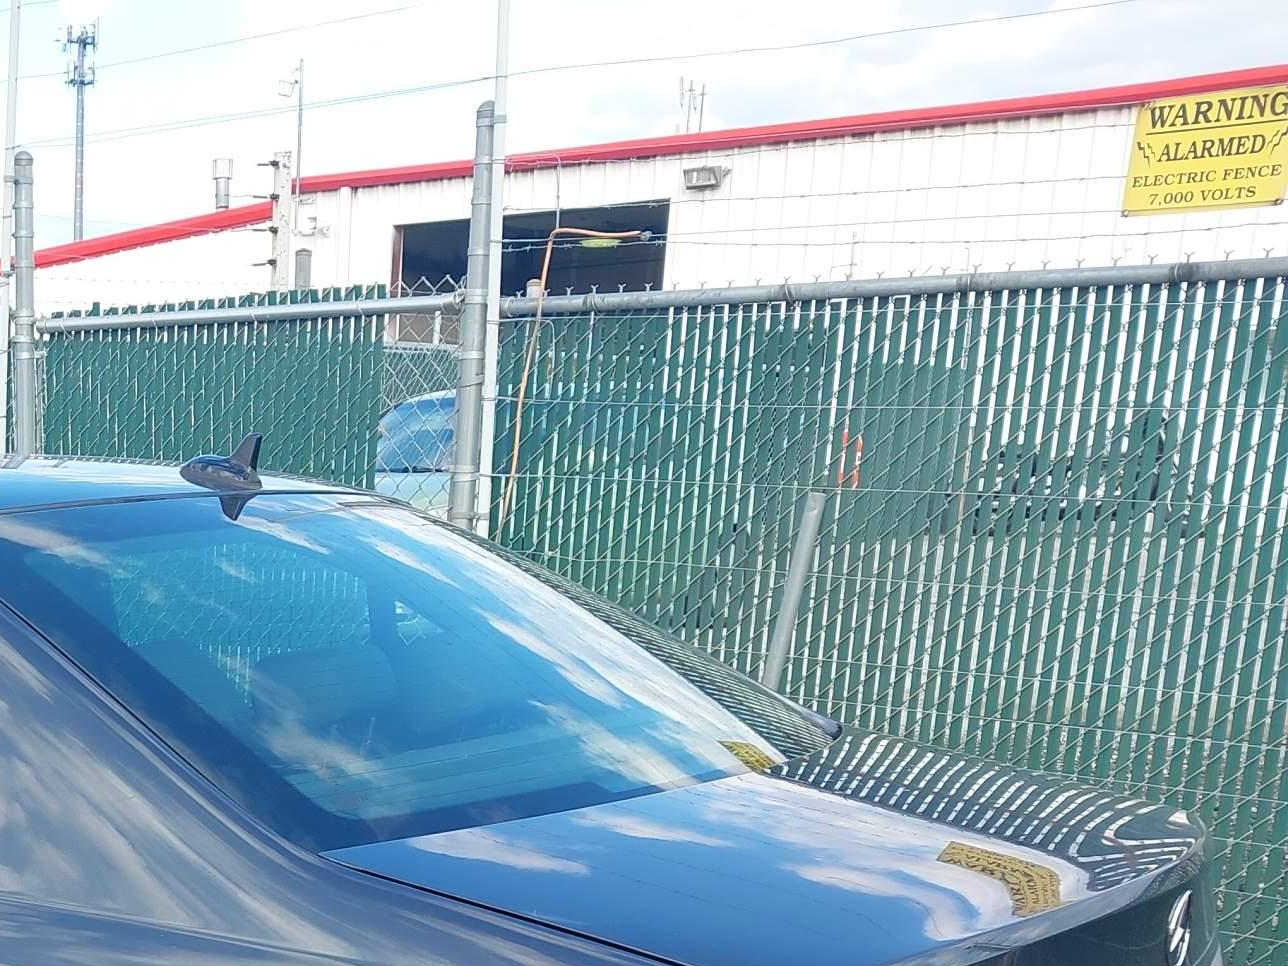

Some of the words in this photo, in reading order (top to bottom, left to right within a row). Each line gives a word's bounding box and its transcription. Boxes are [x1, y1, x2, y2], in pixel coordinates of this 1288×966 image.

[1149, 91, 1288, 129] WARNING
[1157, 134, 1266, 162] ALARMED
[1132, 171, 1216, 188] ELECTRIC
[1222, 164, 1283, 181] FENCE
[1148, 191, 1194, 206] 7,000
[1200, 186, 1257, 202] VOLTS
